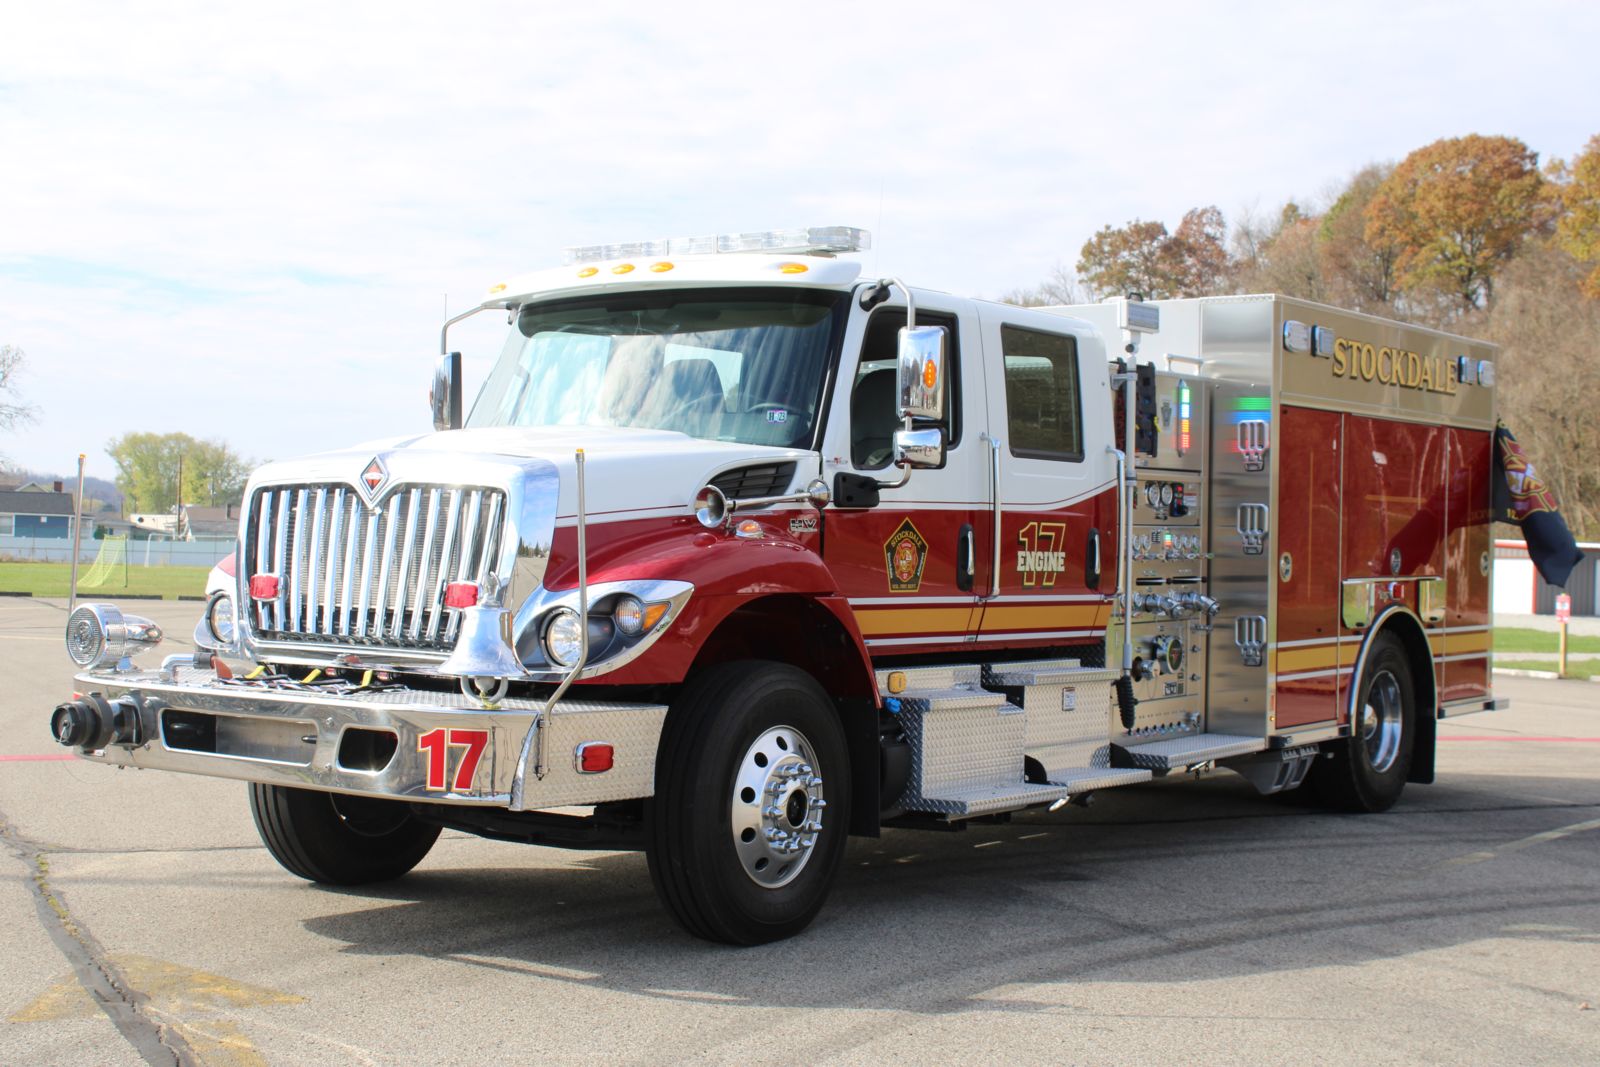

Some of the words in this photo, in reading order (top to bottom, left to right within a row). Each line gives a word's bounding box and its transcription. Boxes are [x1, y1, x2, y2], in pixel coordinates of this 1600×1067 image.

[1333, 337, 1457, 395] STOCKDALE
[1016, 550, 1066, 572] ENGINE
[1018, 521, 1066, 587] 17
[416, 727, 490, 793] 17
